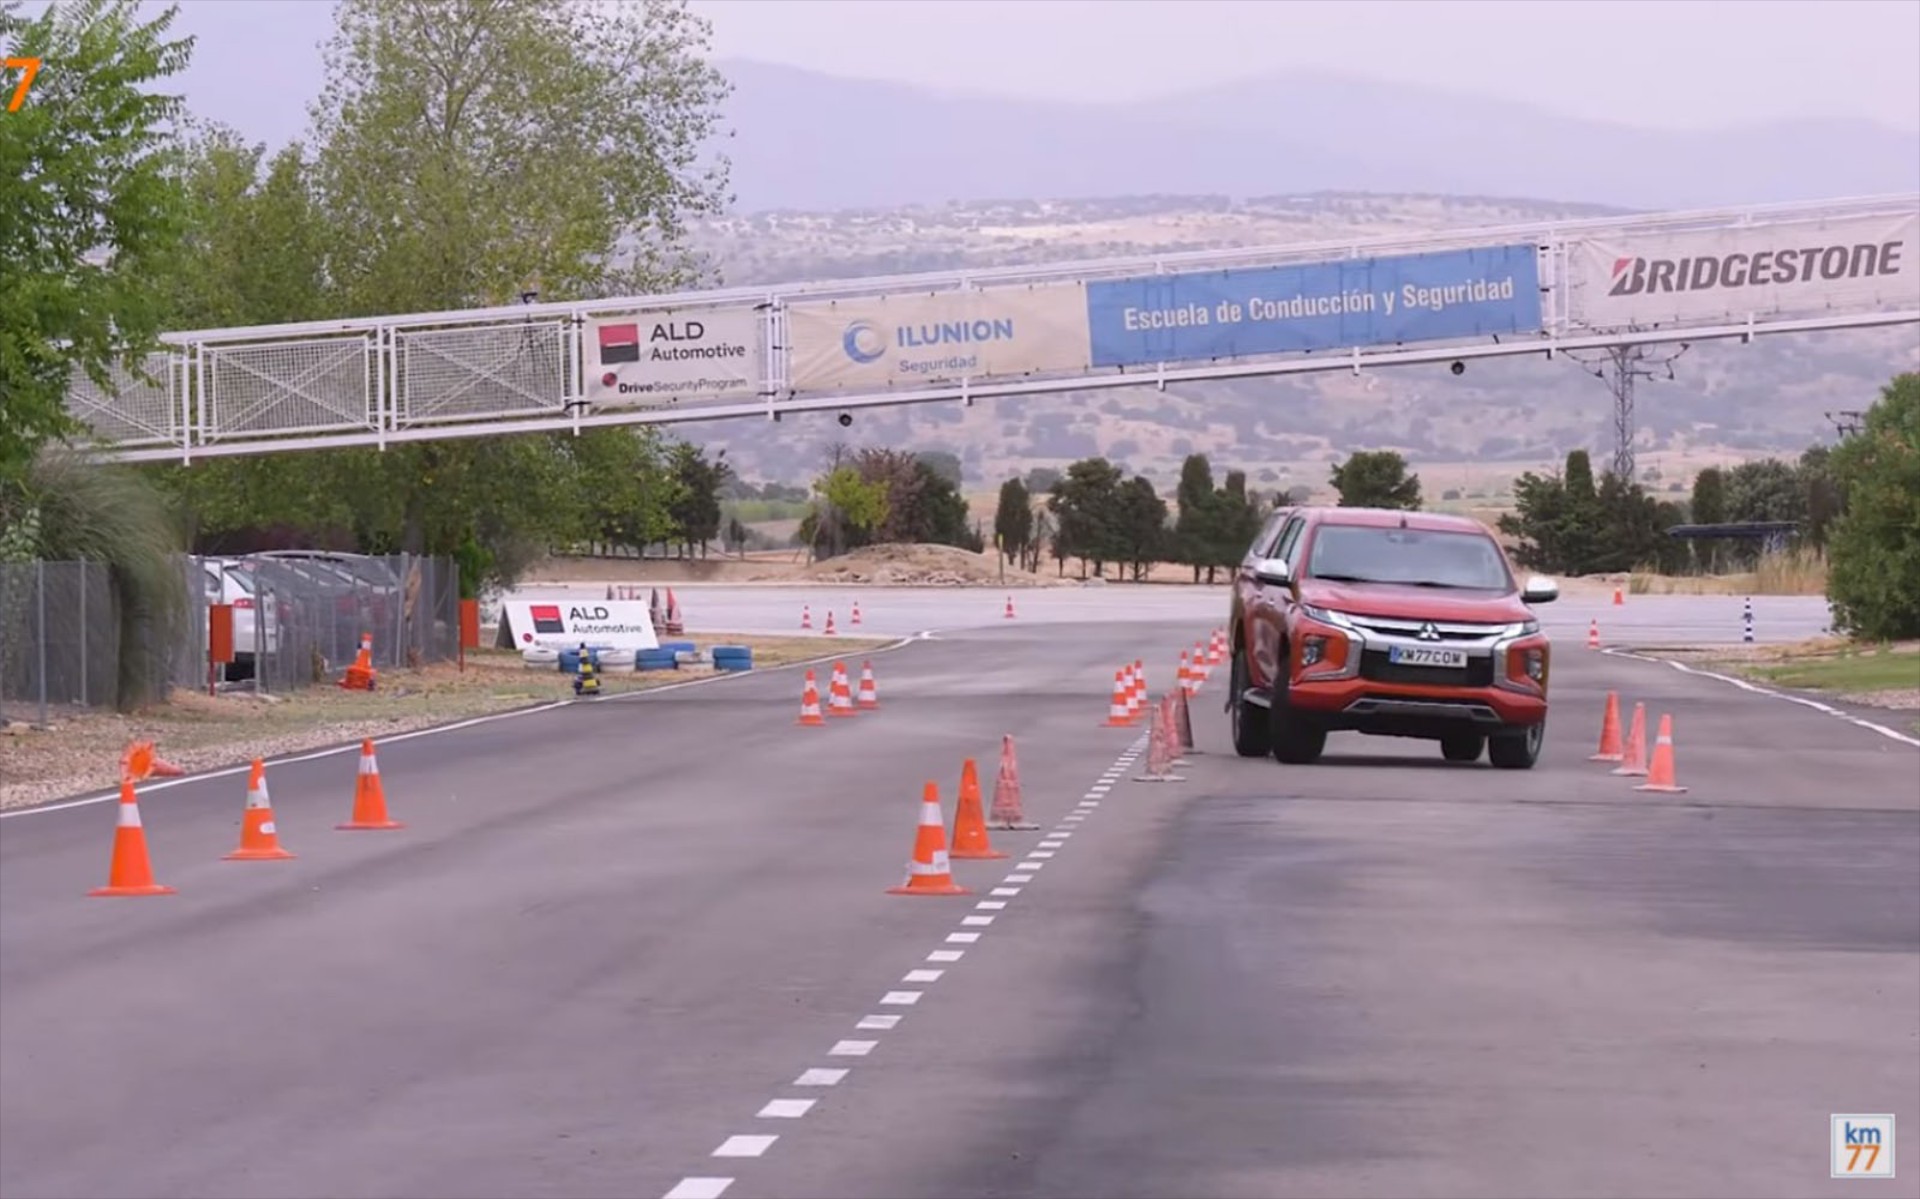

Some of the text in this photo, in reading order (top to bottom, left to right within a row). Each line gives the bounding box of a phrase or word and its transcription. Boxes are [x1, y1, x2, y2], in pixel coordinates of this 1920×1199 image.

[1608, 241, 1903, 297] BRIDGESTONE
[1124, 276, 1514, 330] Escuela de Conducción y Seguridad
[650, 321, 704, 342] ALD
[897, 318, 1013, 347] ILUNION
[651, 342, 746, 361] Automotive
[899, 356, 978, 374] Seguridad
[618, 377, 747, 394] DriveSecurityProgram
[569, 606, 609, 621] ALD
[572, 624, 643, 635] Automotive
